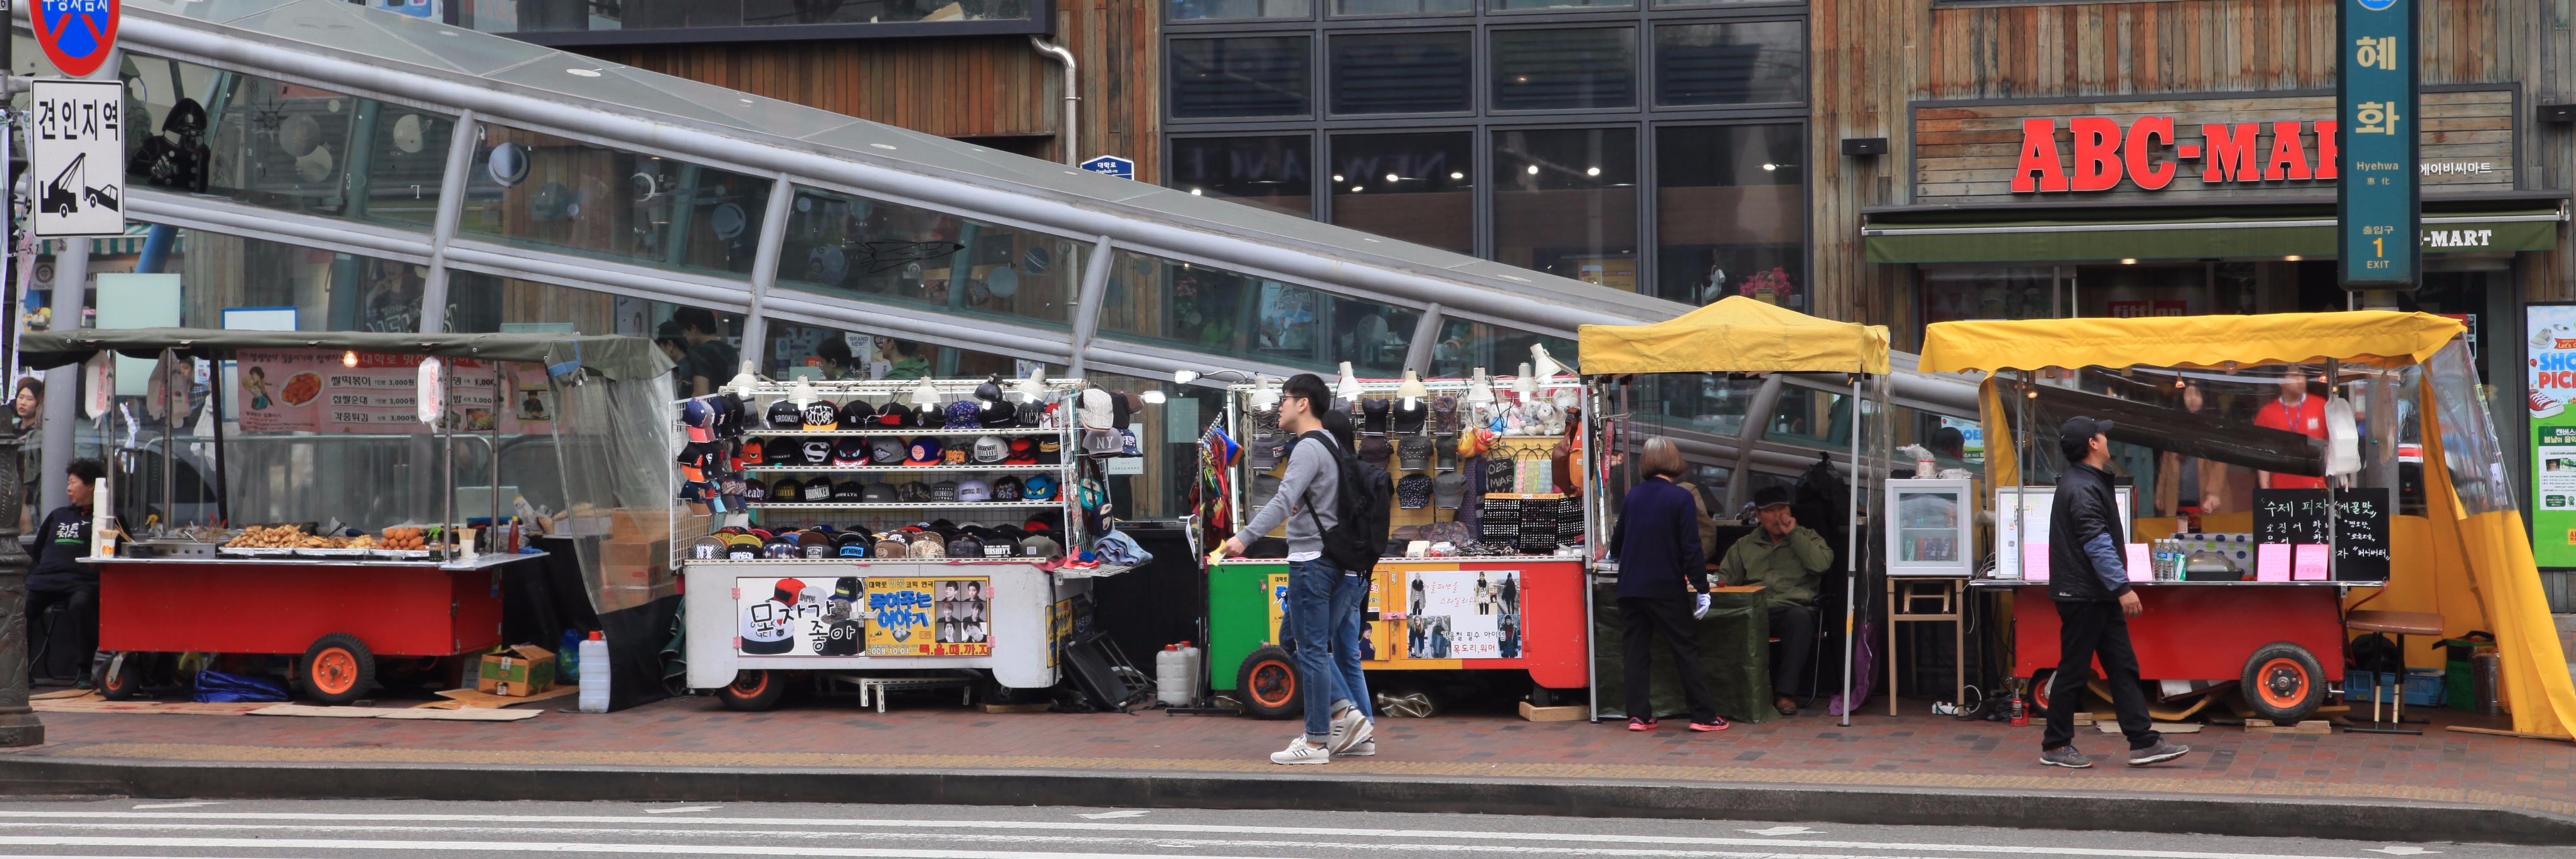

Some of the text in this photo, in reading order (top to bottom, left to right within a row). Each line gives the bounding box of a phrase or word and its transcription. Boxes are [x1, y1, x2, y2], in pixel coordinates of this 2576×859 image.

[39, 98, 117, 141] 견인지역
[2357, 161, 2399, 171] Hyehwa
[2421, 162, 2492, 176] 에이비씨마트
[2363, 226, 2394, 234] 출입구
[2421, 230, 2492, 247] -MART
[2373, 237, 2383, 258] 1
[362, 354, 397, 364] 대학로
[331, 376, 371, 386] 쌀떡볶이
[2539, 371, 2576, 389] PIC
[333, 395, 368, 405] 찹쌀순대
[334, 412, 368, 422] 각종튀김
[775, 414, 799, 423] BROOKLYN
[1096, 436, 1114, 449] NY
[805, 486, 830, 500] DRUNKEN
[2264, 500, 2294, 517] 수제
[2302, 498, 2330, 516] 피자
[869, 590, 933, 611] 죽어주는
[751, 600, 836, 632] 모자가
[877, 608, 930, 631] 이야기
[808, 620, 856, 651] 좋아
[1441, 631, 1506, 642] 겨울철 필수 아이템
[1453, 644, 1496, 654] 목도리,워머
